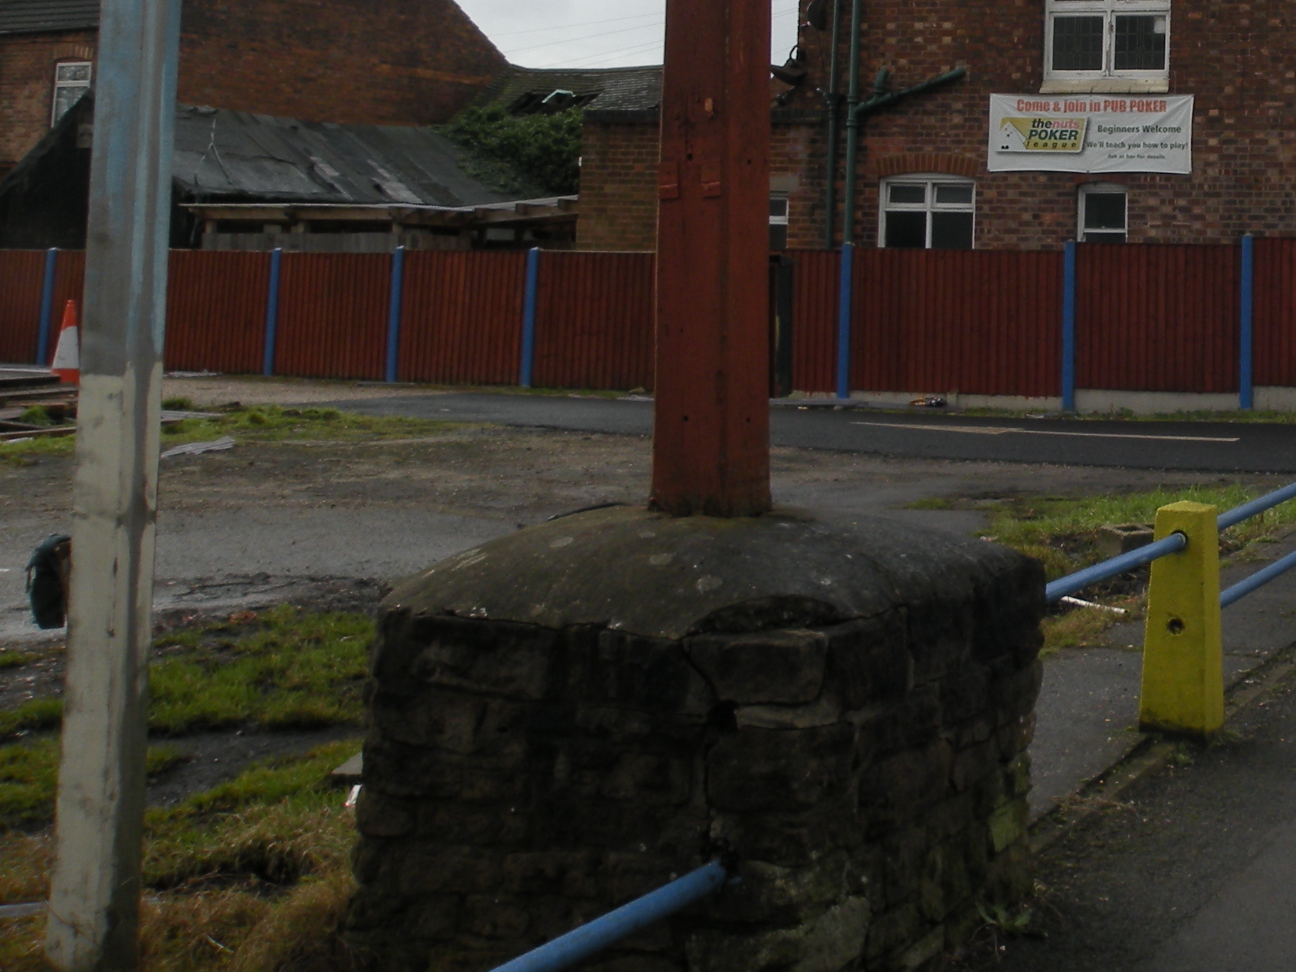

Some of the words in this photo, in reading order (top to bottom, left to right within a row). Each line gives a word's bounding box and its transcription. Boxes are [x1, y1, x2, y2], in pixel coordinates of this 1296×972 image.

[1016, 98, 1051, 112] Come
[1053, 101, 1061, 112] &
[1089, 100, 1101, 112] in
[1103, 100, 1127, 113] PUB
[1129, 100, 1167, 113] POKER
[1028, 129, 1079, 141] POKER
[1097, 125, 1140, 135] Beginners
[1142, 125, 1182, 134] Welcome
[1026, 140, 1077, 149] league
[1127, 142, 1141, 150] you
